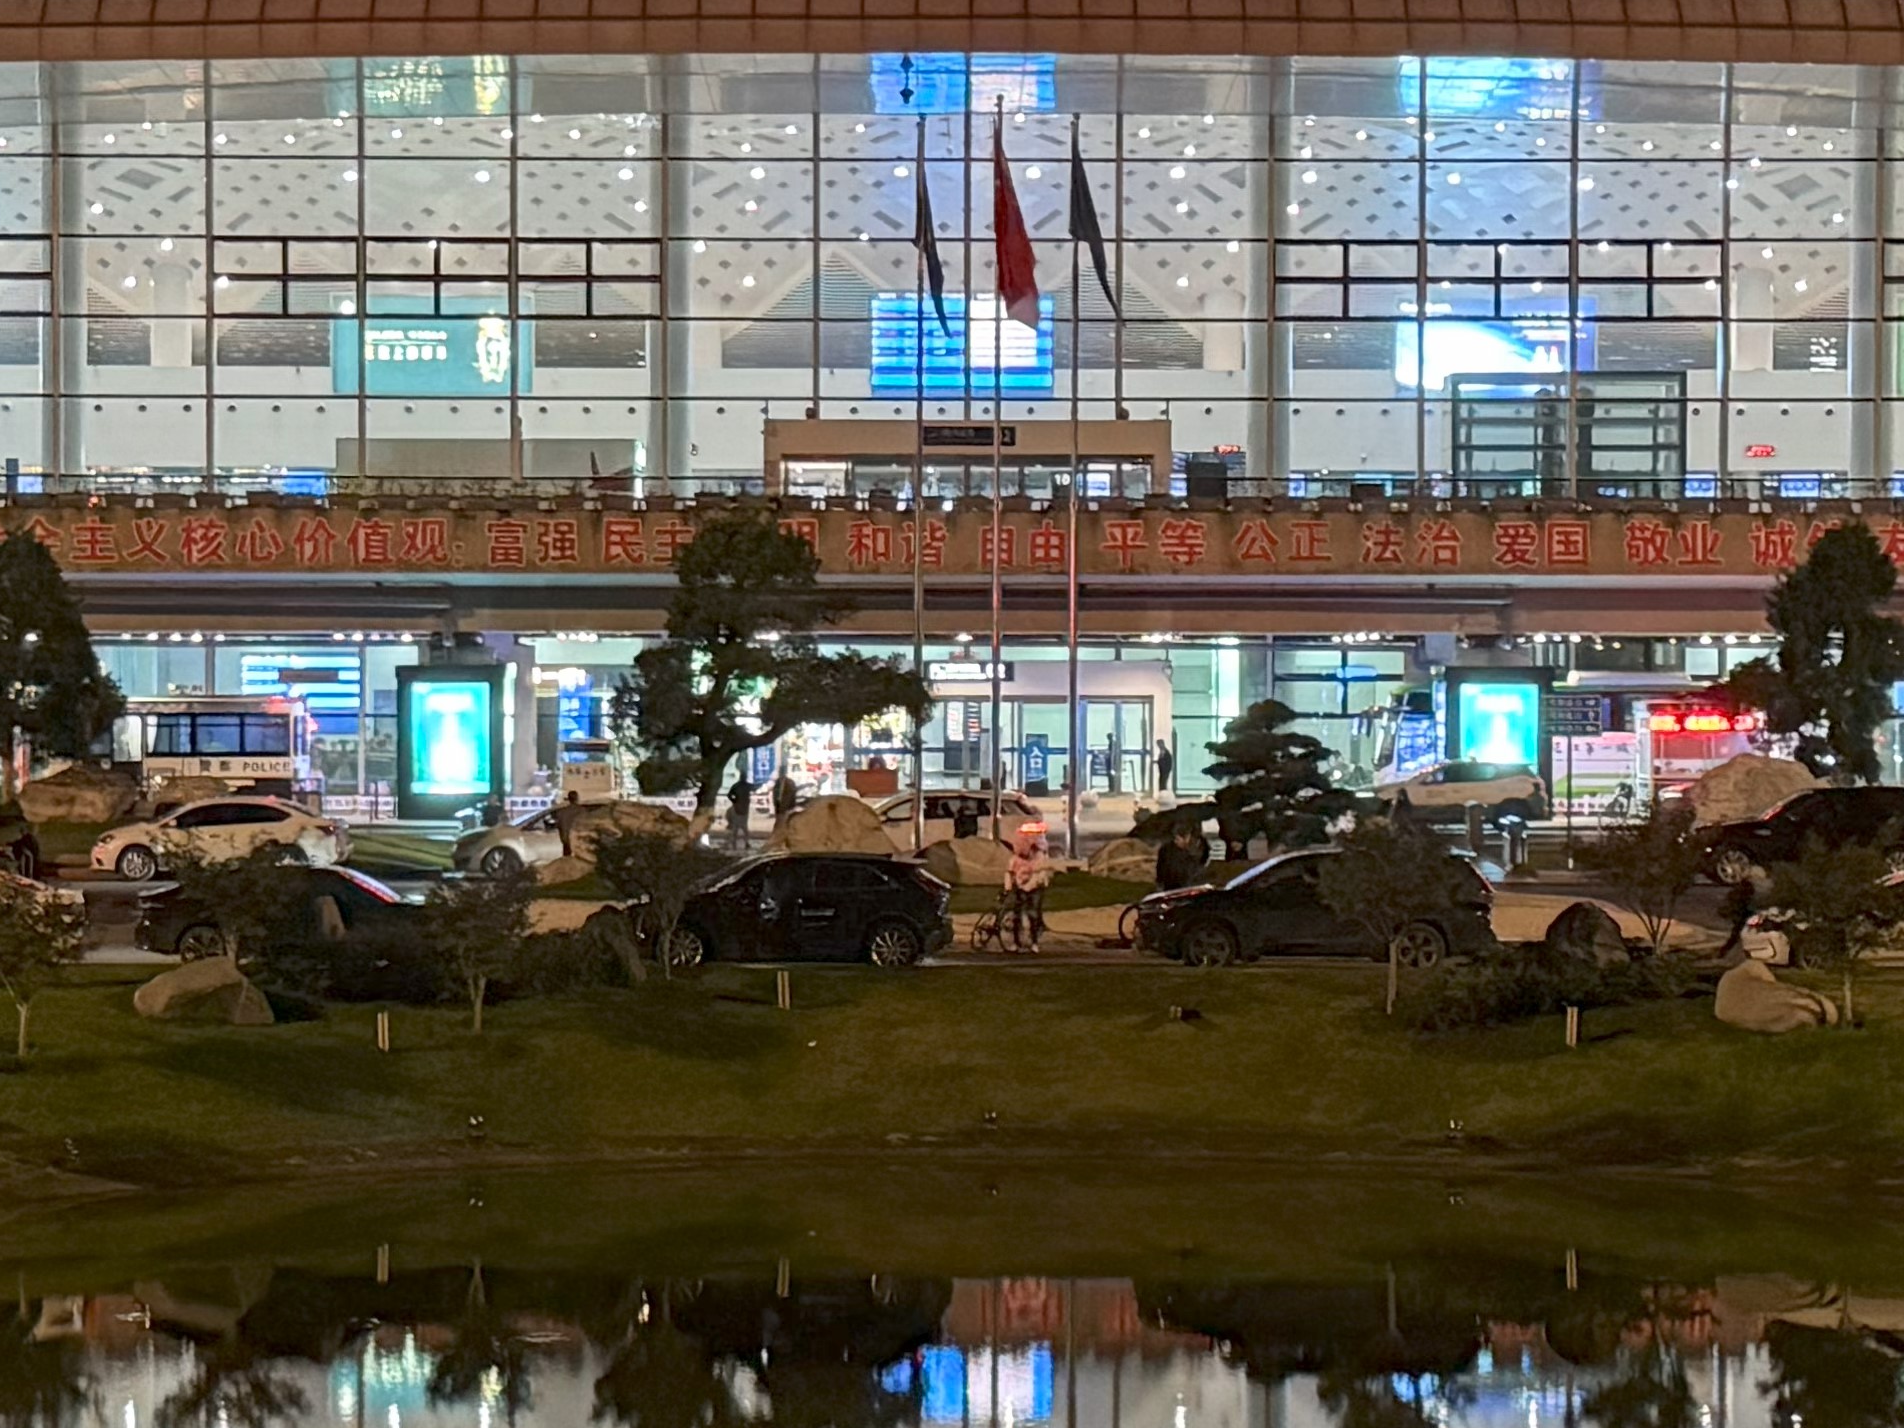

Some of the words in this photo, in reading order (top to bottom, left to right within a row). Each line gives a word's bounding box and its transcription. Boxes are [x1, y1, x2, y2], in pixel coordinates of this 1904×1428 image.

[485, 517, 579, 567] 富强
[602, 517, 696, 565] 民主
[847, 518, 950, 567] 和谐
[979, 518, 1069, 567] 自由
[1100, 518, 1208, 568] 平等
[1232, 518, 1333, 564] 公正
[1360, 519, 1463, 567] 法治
[1493, 519, 1592, 568] 爱国
[1624, 520, 1724, 568] 敬业
[243, 761, 291, 773] POLICE
